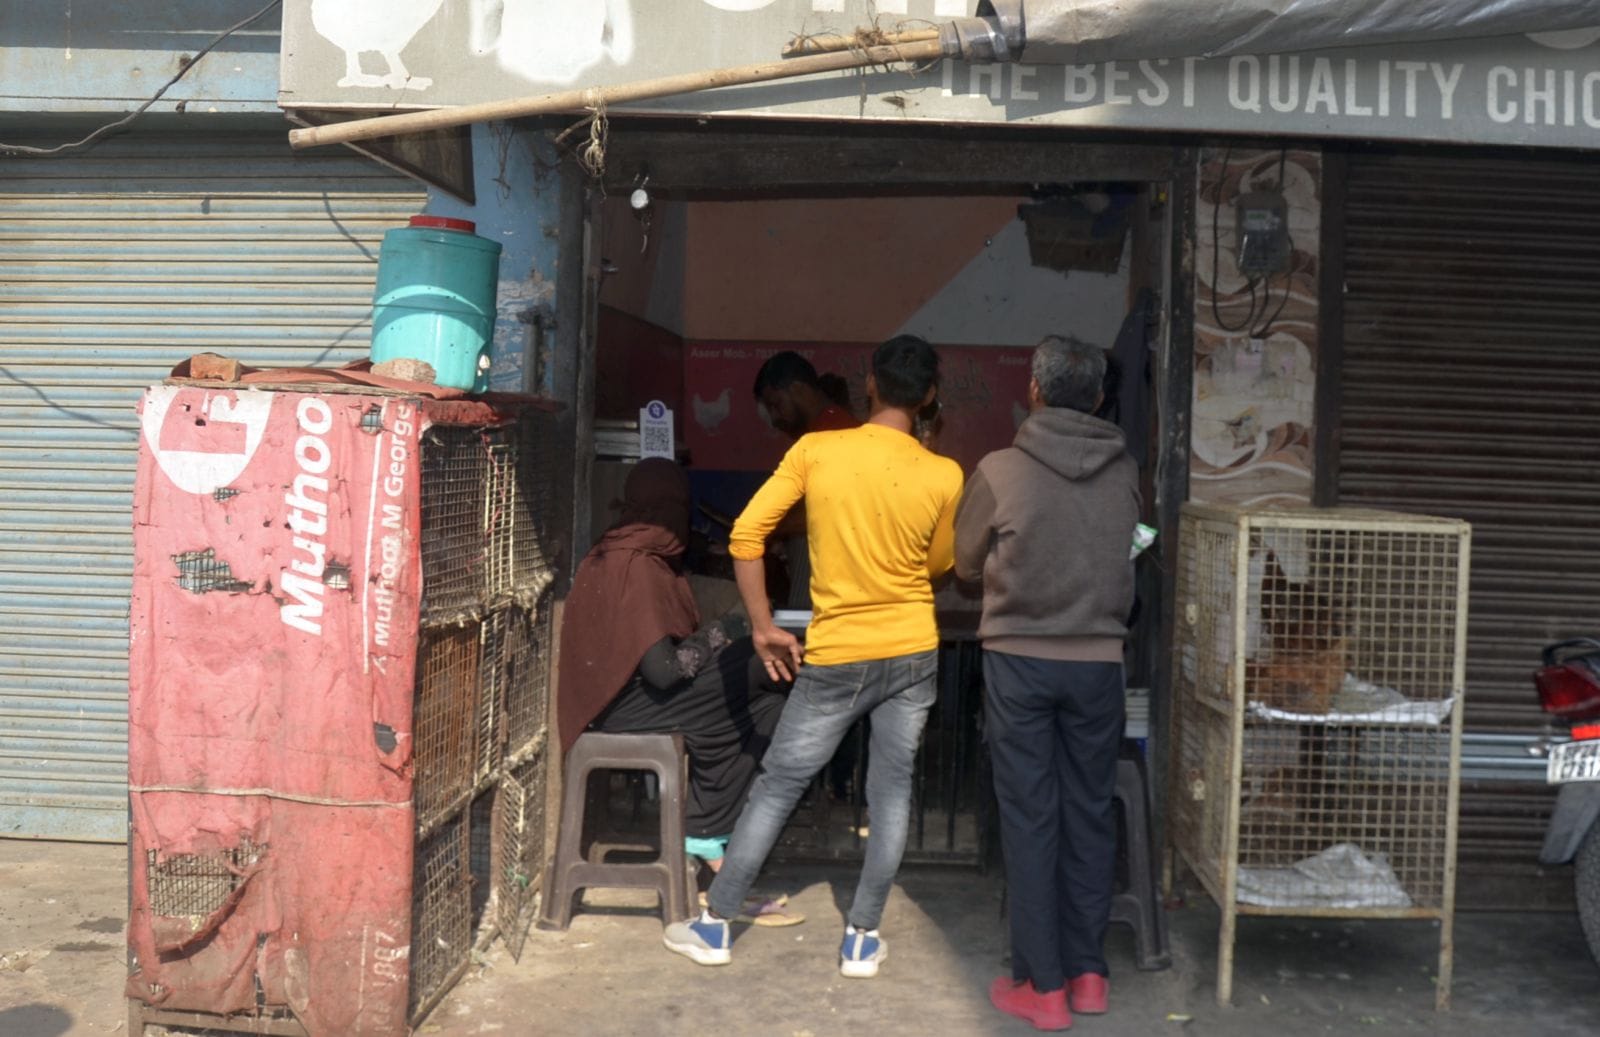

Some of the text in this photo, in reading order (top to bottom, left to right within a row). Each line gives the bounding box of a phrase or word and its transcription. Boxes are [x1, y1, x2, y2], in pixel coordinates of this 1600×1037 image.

[1228, 54, 1464, 119] QUALITY
[384, 404, 413, 498] George
[381, 504, 402, 528] M
